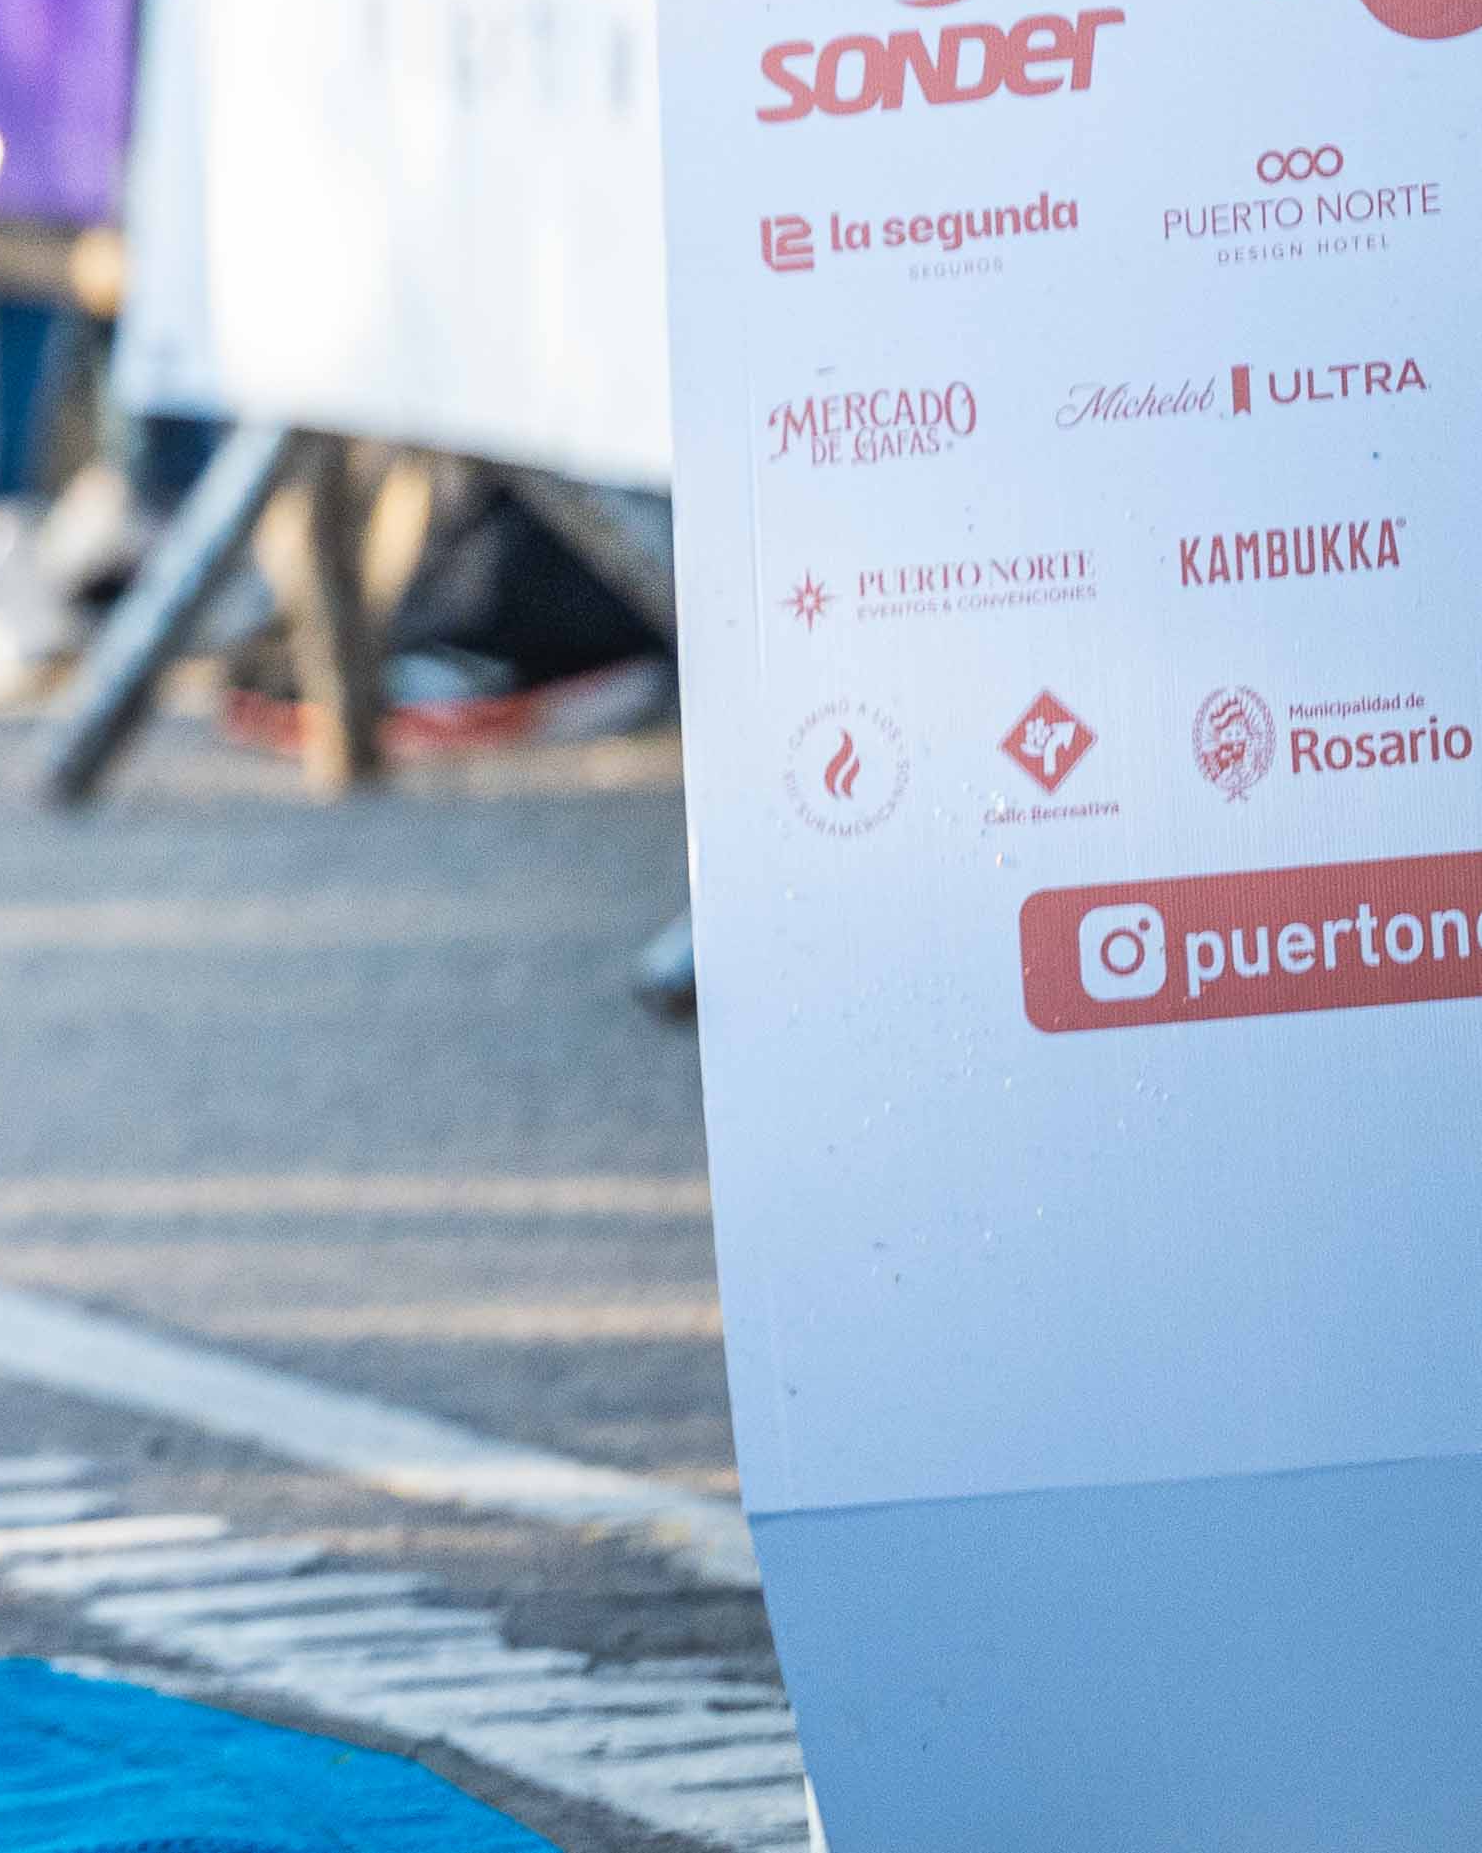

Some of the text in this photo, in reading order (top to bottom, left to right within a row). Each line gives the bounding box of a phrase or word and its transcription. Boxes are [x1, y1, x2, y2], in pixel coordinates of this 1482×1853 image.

[830, 190, 1079, 253] la segunda
[1163, 182, 1442, 240] PUERTO NORTE
[908, 257, 1004, 282] SEGUROS
[1218, 235, 1392, 265] DESIGN HOTEL
[1054, 358, 1428, 429] Michelob ULTRA
[768, 381, 977, 463] MERCADO
[811, 432, 843, 466] DE
[858, 548, 1097, 597] PUERTO NORTE
[1179, 517, 1401, 588] KAMBUKKA
[857, 599, 939, 620] EVENTOS
[956, 584, 1097, 612] CONVENCIONES
[1289, 691, 1426, 721] Municipalidad de
[1290, 714, 1473, 774] Rosario
[984, 800, 1121, 825] Calle Recreativa
[1185, 903, 1482, 998] puerton
